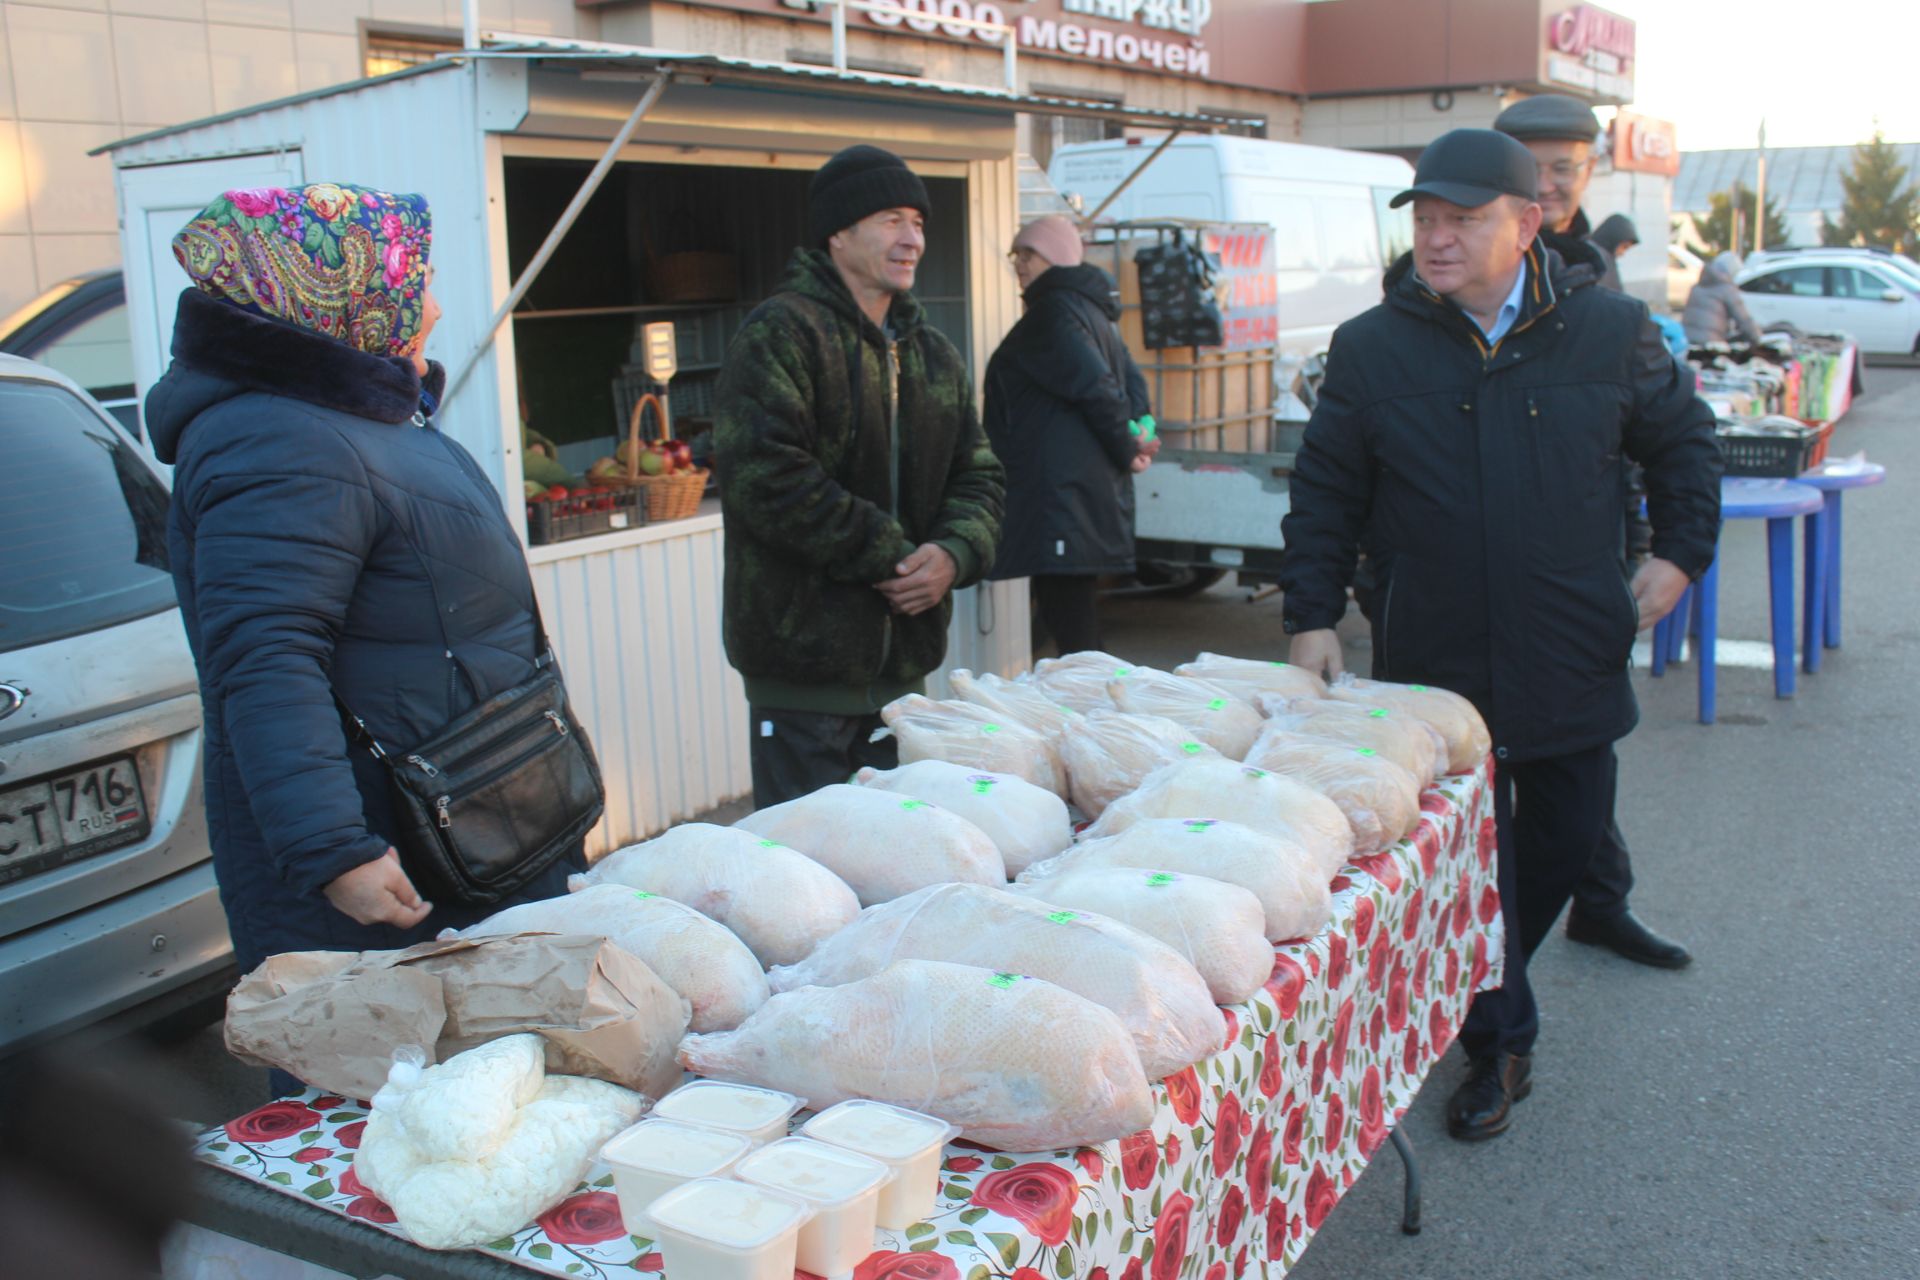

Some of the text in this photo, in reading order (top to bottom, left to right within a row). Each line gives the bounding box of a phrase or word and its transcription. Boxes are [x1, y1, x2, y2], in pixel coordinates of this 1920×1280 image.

[1020, 16, 1210, 75] мелочей
[55, 767, 126, 822] 716
[79, 811, 114, 833] RUS
